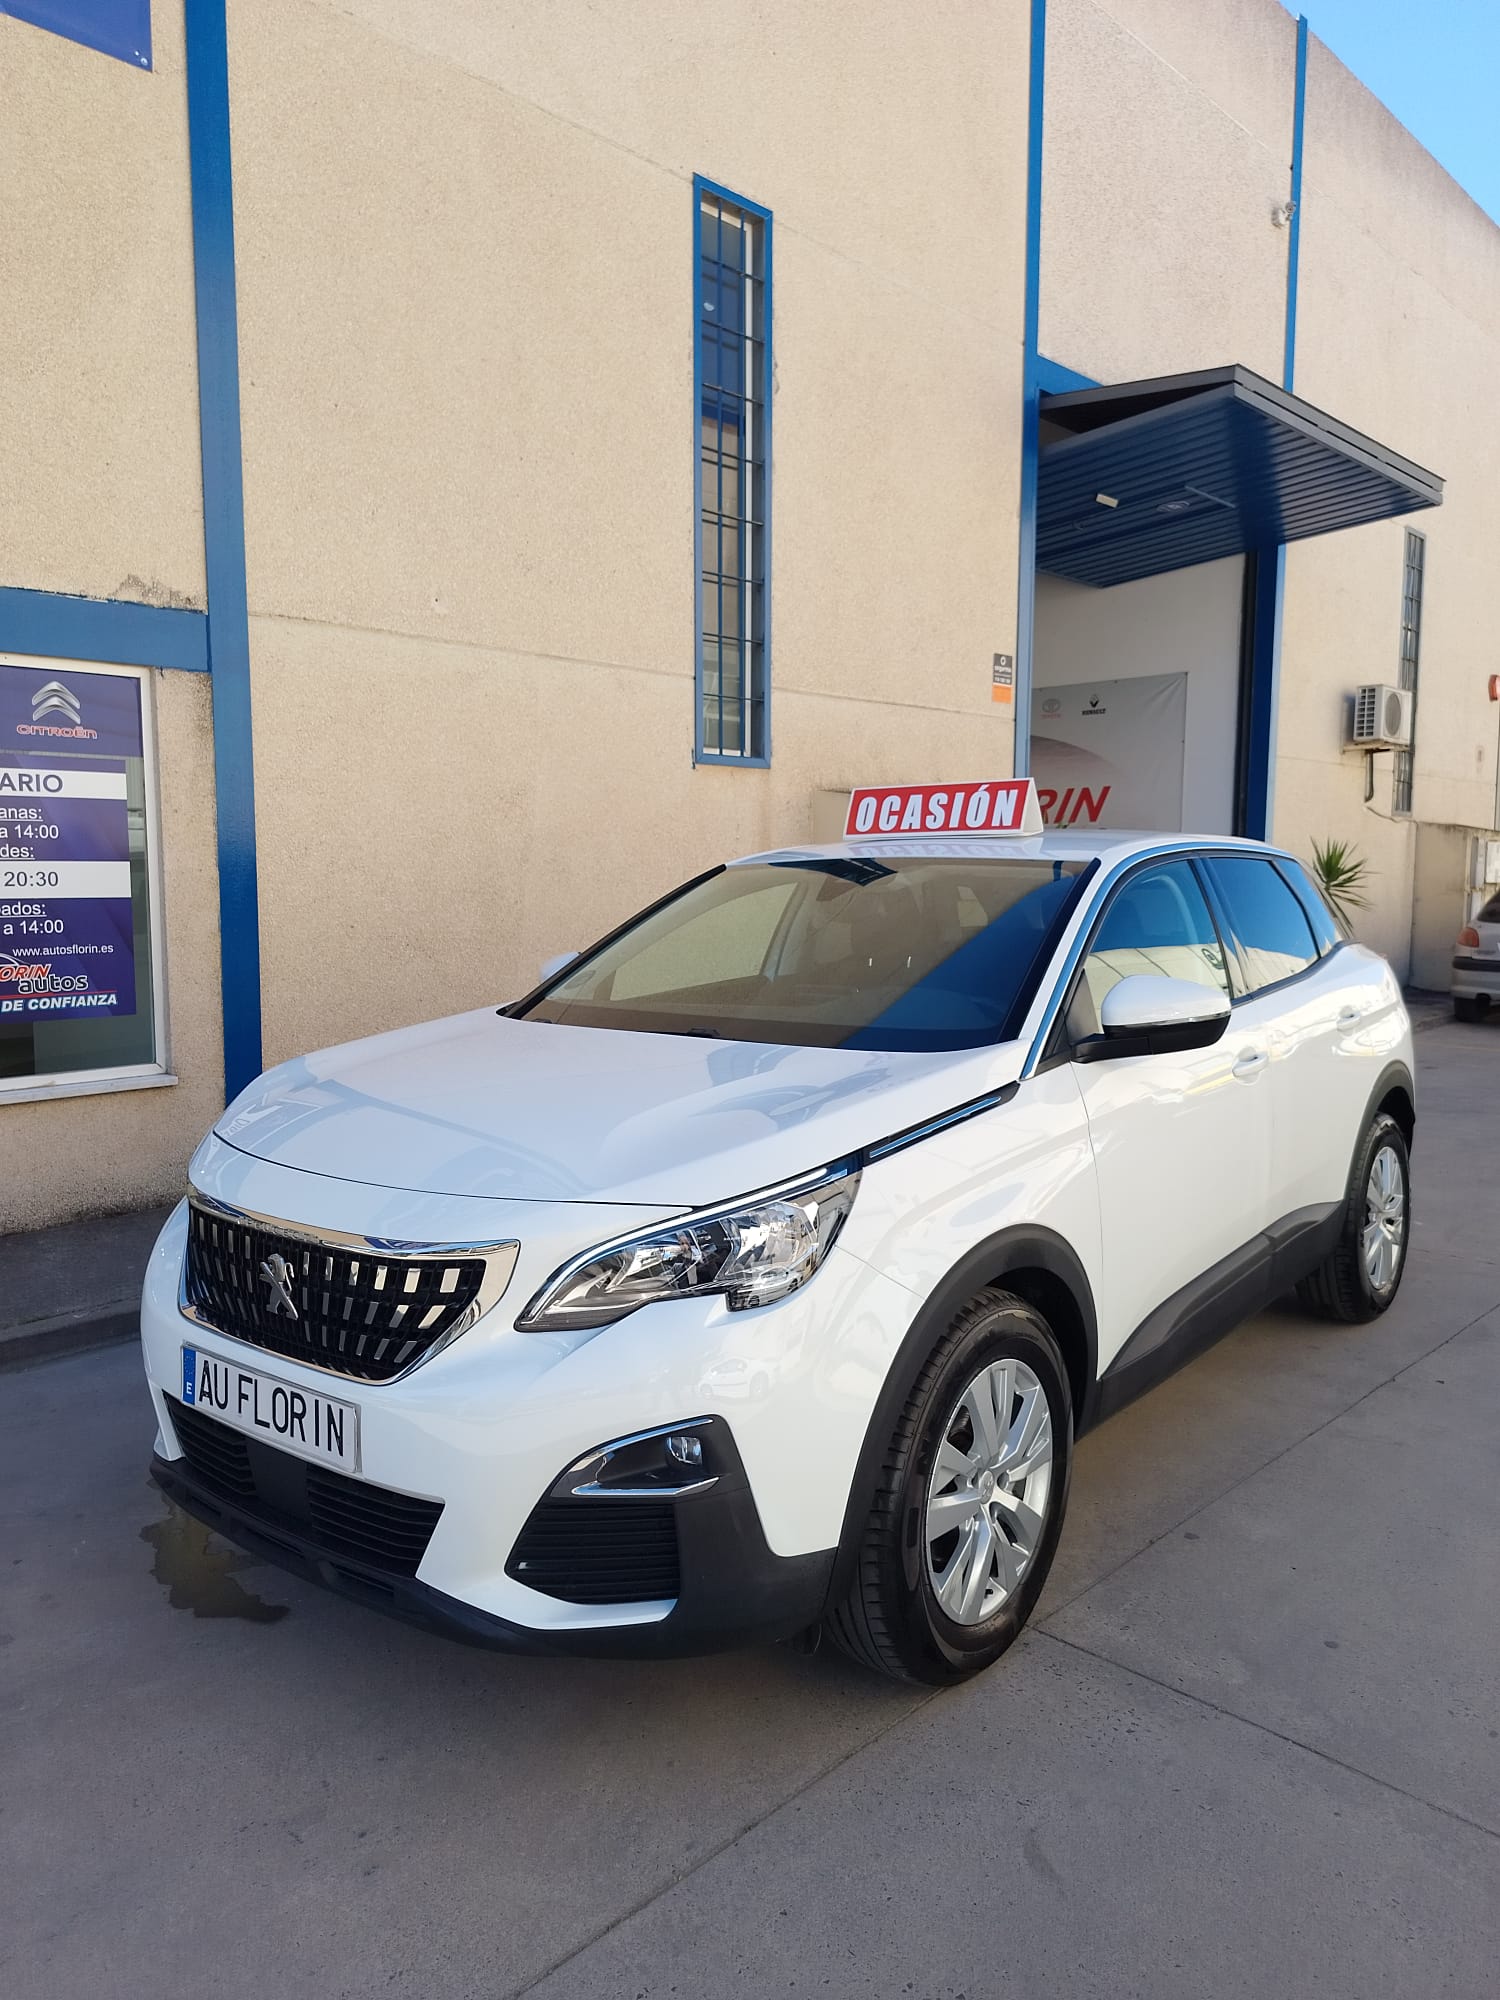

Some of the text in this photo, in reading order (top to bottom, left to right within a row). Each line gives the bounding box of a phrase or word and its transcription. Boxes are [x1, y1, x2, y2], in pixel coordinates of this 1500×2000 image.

[0, 772, 63, 793] ARIO
[855, 786, 1019, 832] OCASIÓN
[15, 824, 59, 839] 14:00
[0, 843, 34, 859] des:
[4, 871, 58, 887] 20:30
[0, 901, 46, 916] ados:
[3, 919, 64, 935] a 14:00
[12, 944, 114, 957] www.autosflorin.es
[18, 974, 88, 994] autos
[1, 994, 118, 1012] DE CONFIANZA
[186, 1382, 193, 1395] E
[199, 1360, 344, 1456] AU FLORIN
